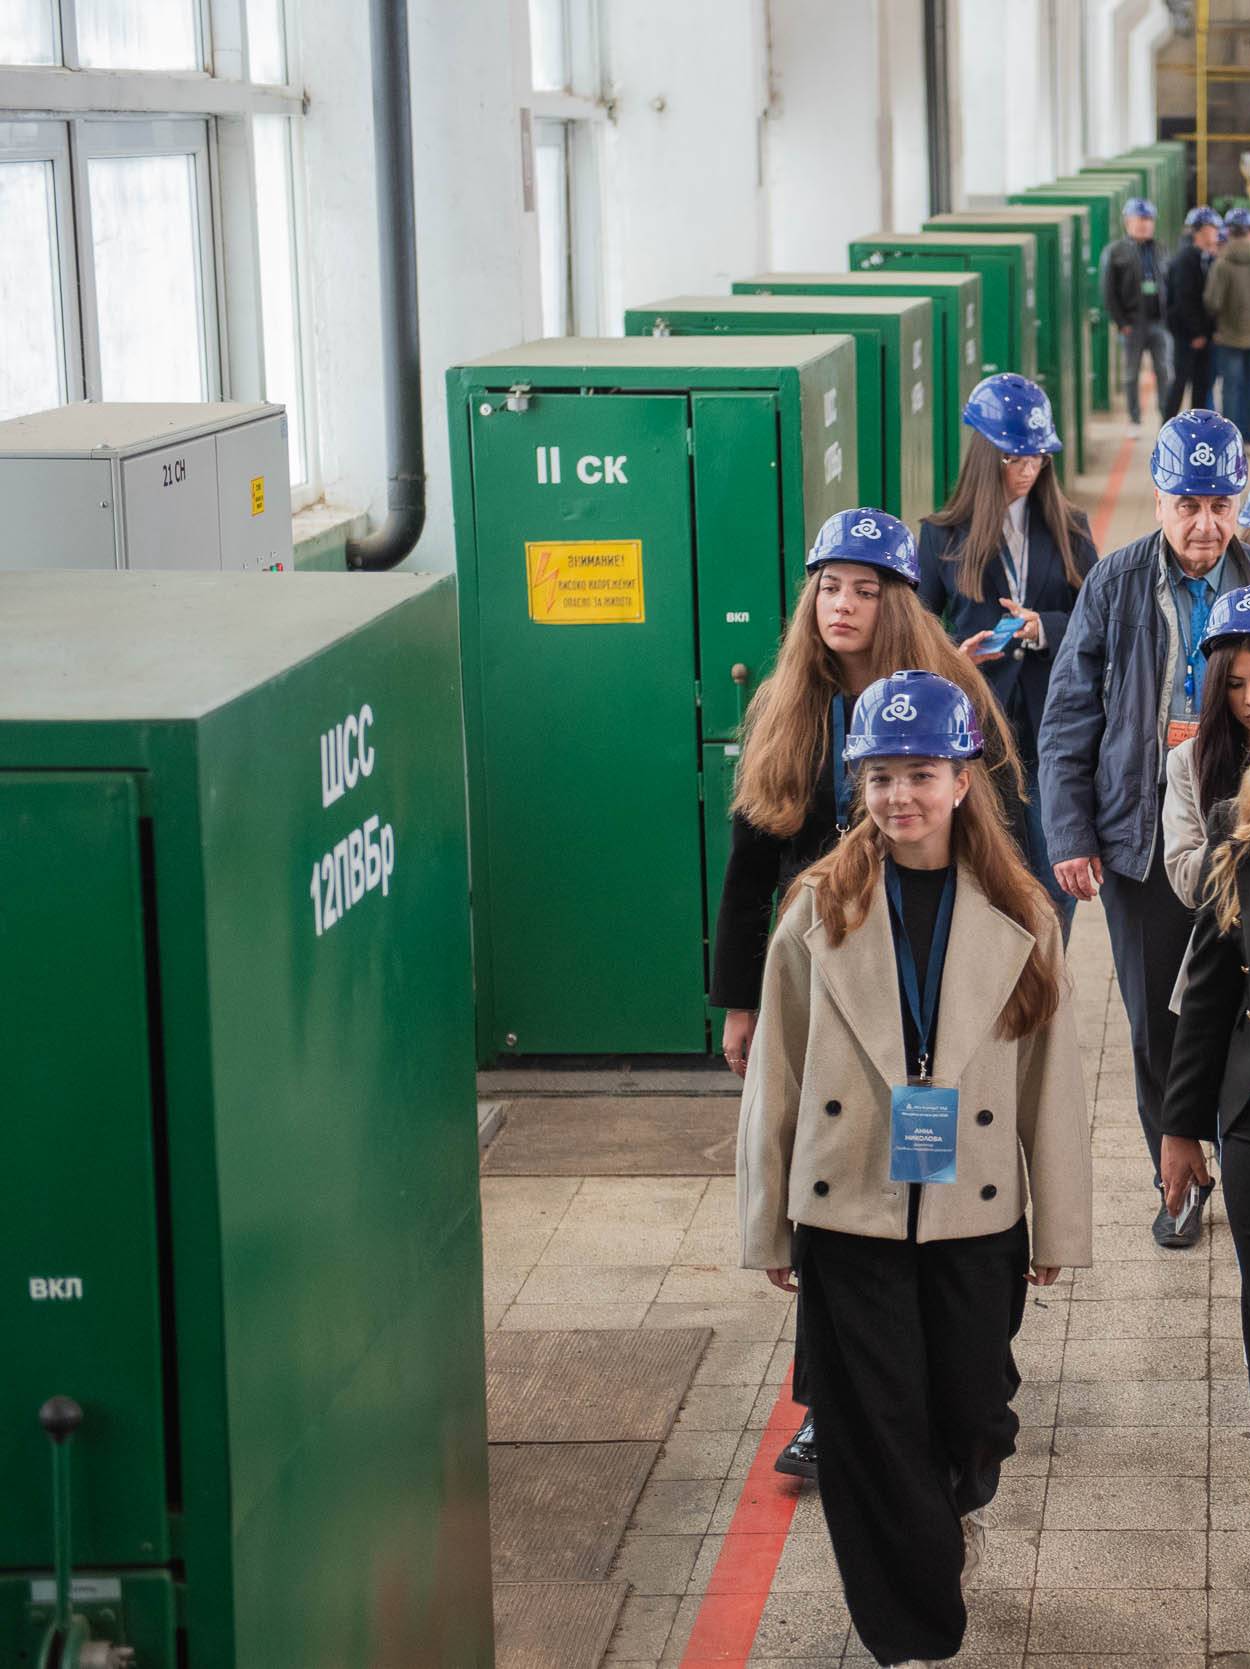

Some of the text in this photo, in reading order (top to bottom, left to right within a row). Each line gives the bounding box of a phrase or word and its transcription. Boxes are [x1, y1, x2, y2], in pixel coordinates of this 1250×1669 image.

[163, 459, 187, 487] 21 СН
[726, 611, 750, 623] ВКЛ
[320, 703, 375, 808] ШСС
[310, 814, 395, 937] 12ПВБр
[29, 1276, 84, 1300] ВКЛ
